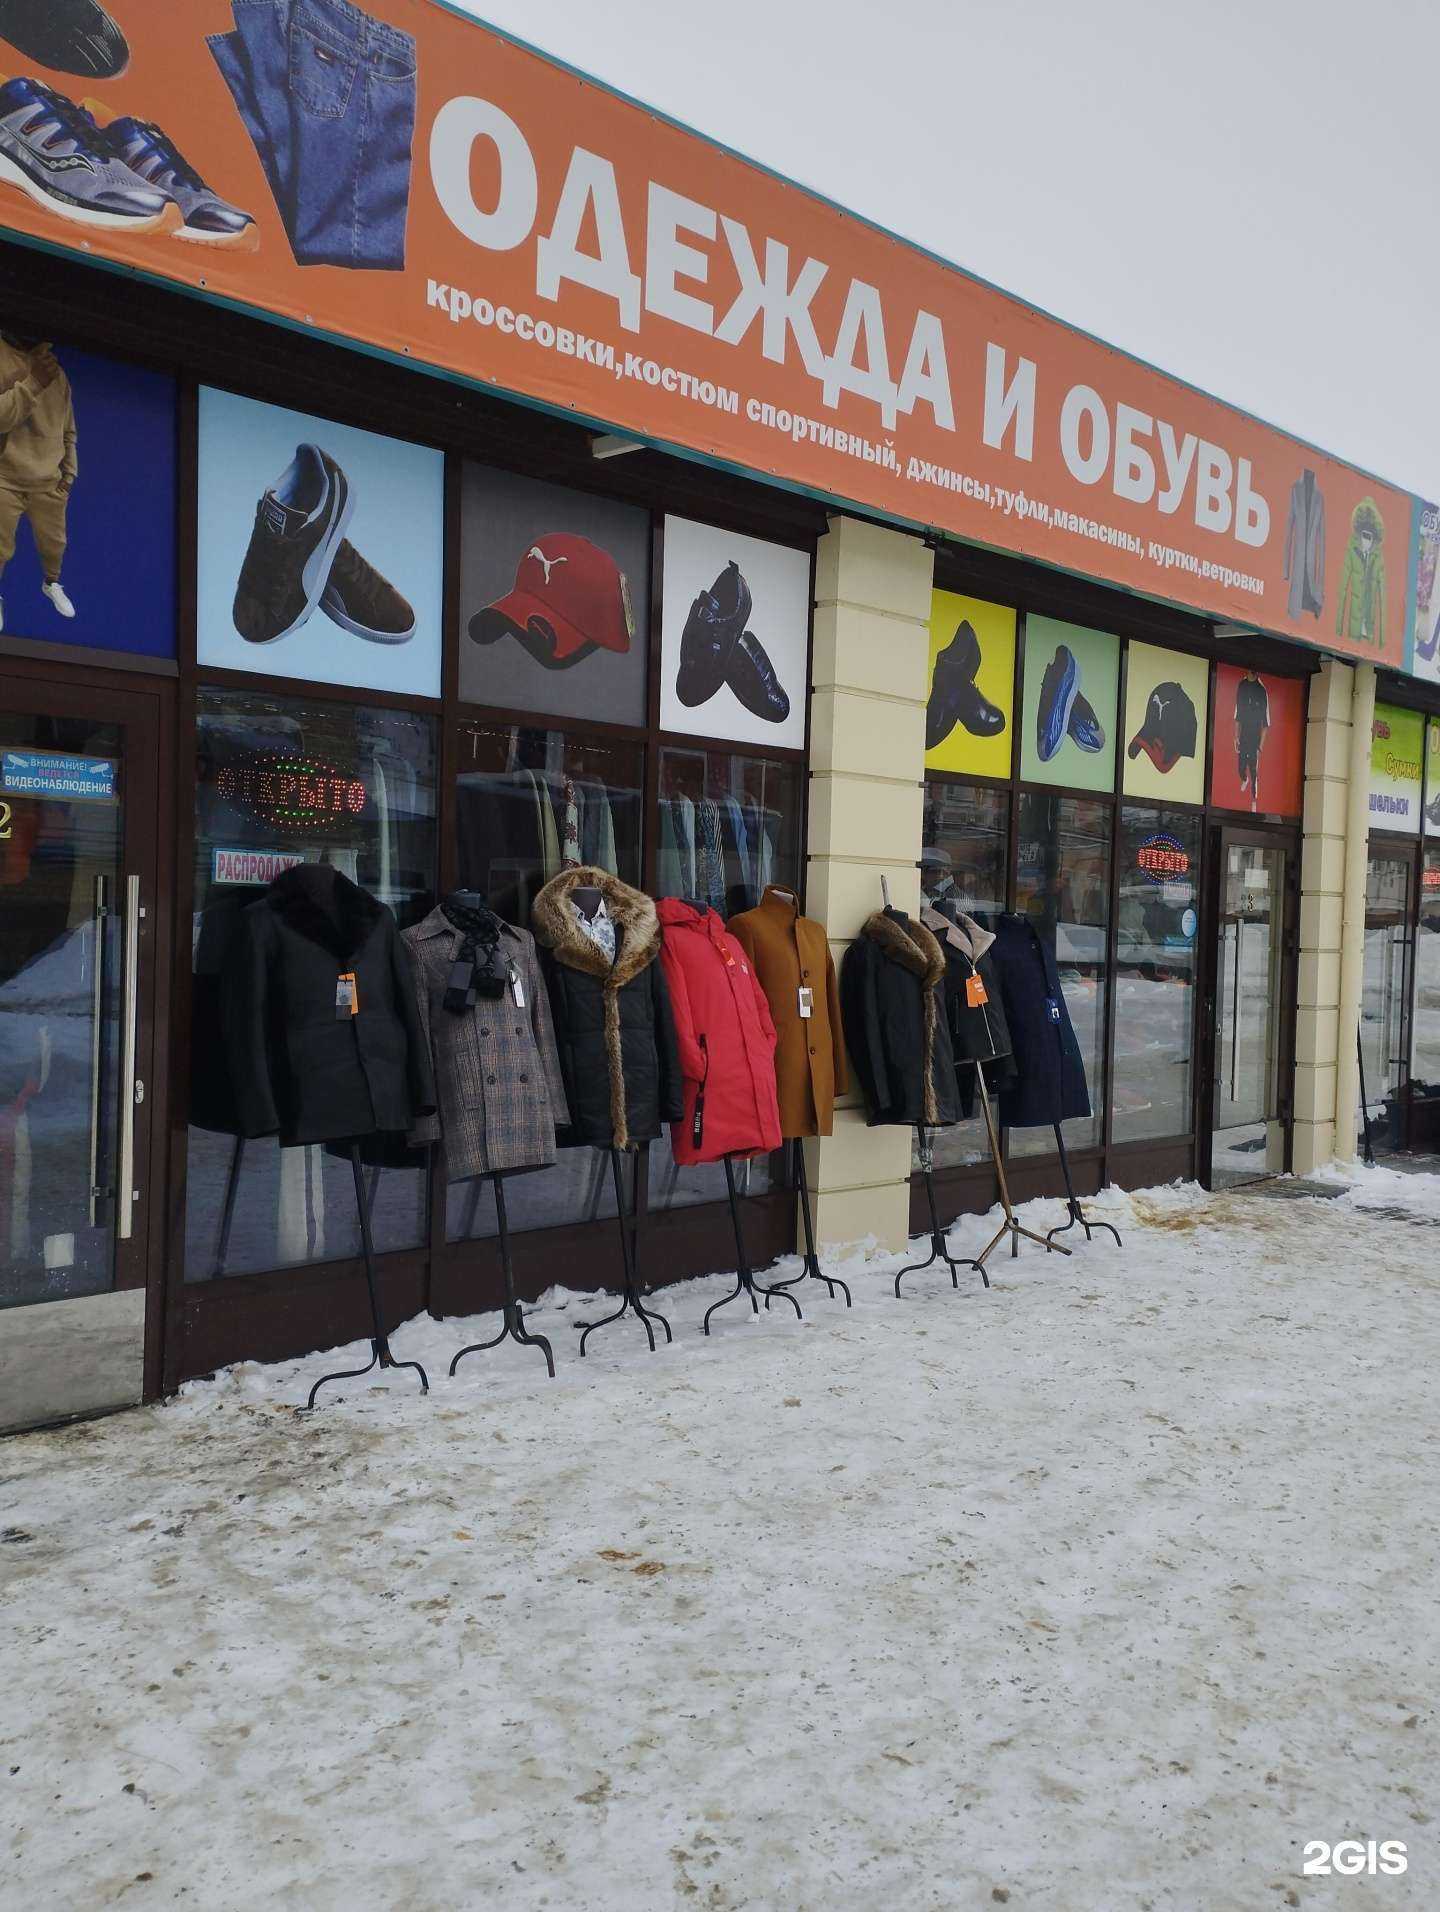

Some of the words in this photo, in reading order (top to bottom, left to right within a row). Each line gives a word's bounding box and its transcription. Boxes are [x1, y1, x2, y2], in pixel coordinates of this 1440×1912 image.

[429, 96, 956, 432] ОДЕЖДА
[983, 342, 1038, 462] И
[1060, 384, 1271, 548] ОБУВЬ
[746, 398, 902, 477] спортивный,
[30, 758, 87, 771] ВНИМАНИЕ!
[1385, 752, 1420, 781] Сумки
[5, 775, 113, 794] ВИДЕОНАБЛЮДЕНИЕ
[218, 768, 366, 812] ОТКРЫТО
[217, 853, 294, 881] РАСПРОДА
